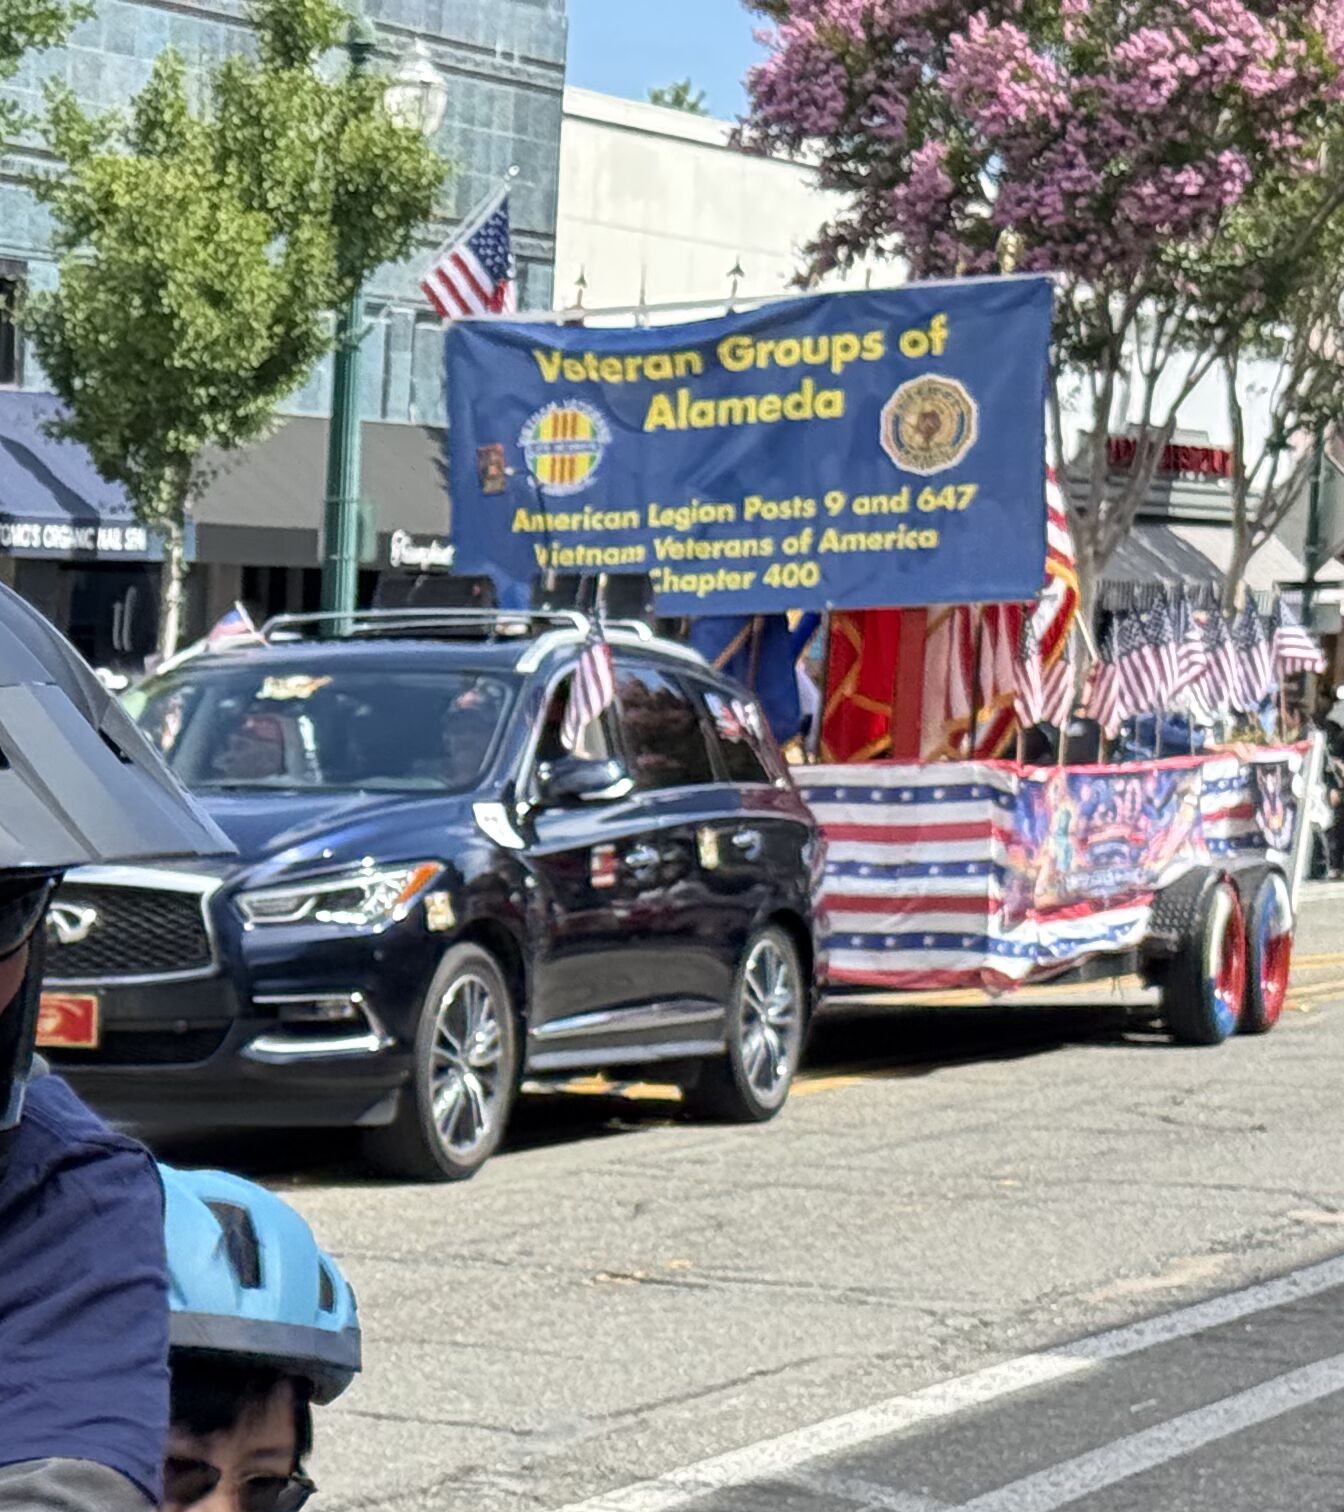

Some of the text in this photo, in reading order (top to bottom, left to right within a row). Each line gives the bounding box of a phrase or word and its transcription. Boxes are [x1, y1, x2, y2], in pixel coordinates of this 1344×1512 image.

[532, 312, 949, 384] Veteran Groups of
[643, 378, 844, 432] Alameda
[512, 483, 979, 533] American Legion Posts 9 and 647
[533, 523, 940, 568] Vietnam Veterans of America
[762, 561, 821, 589] 400
